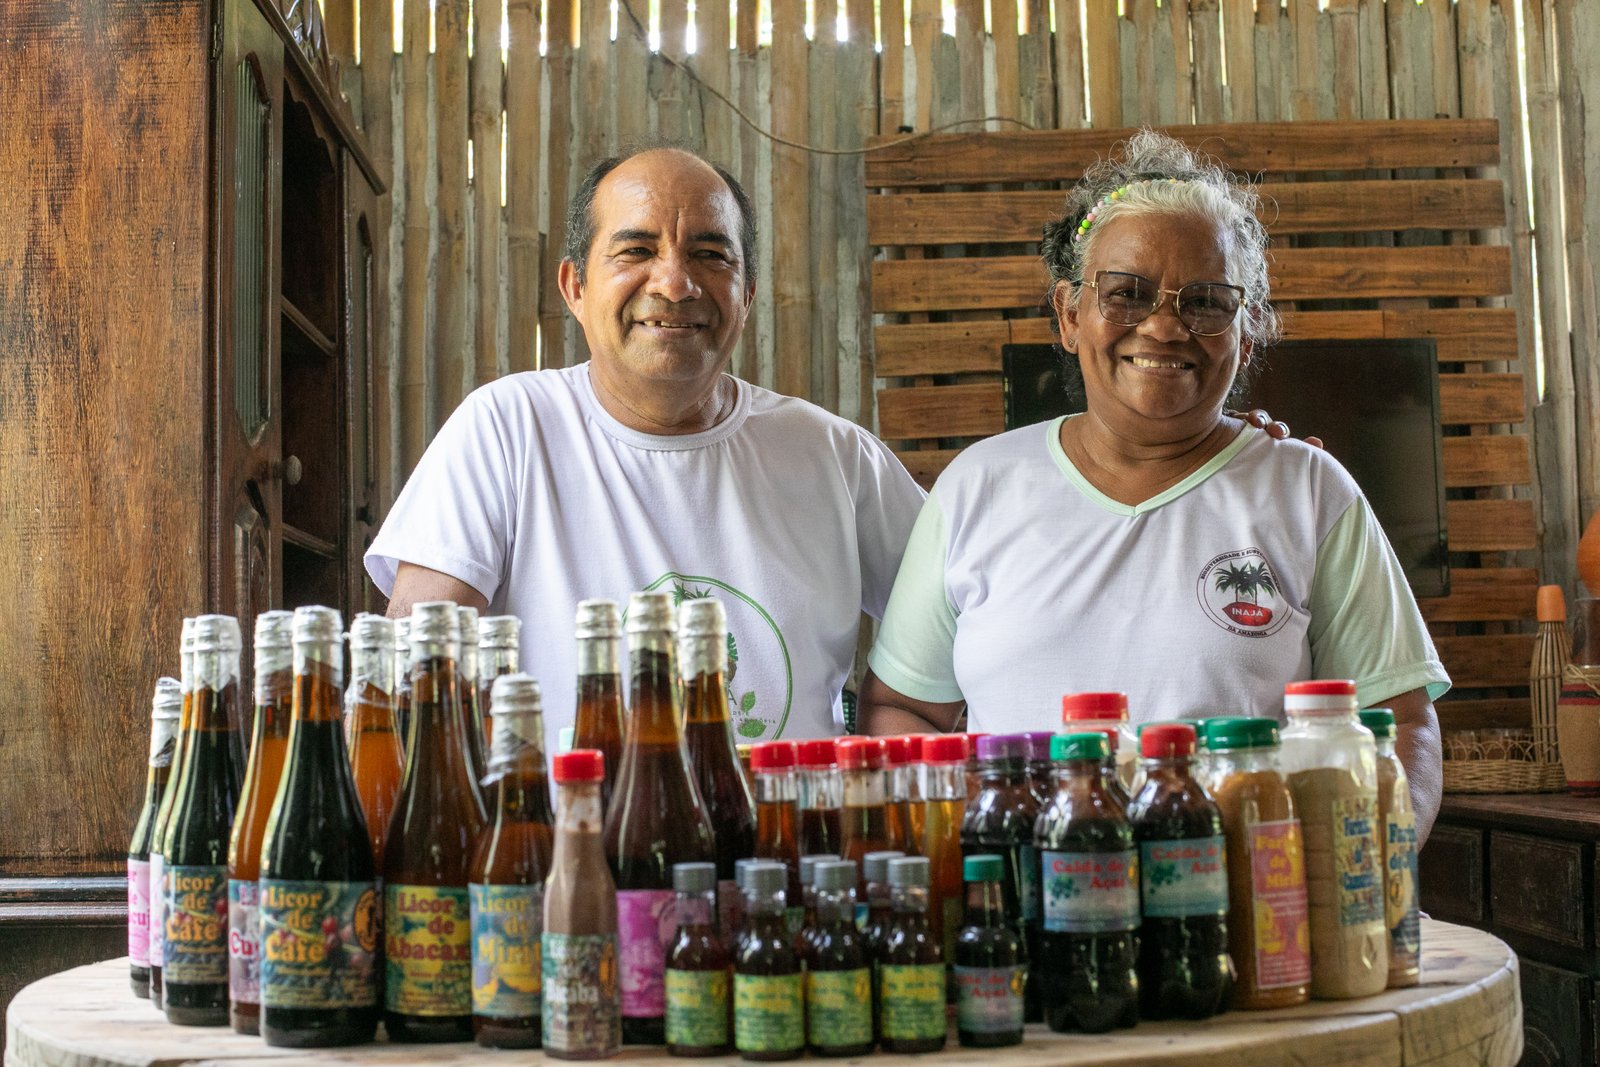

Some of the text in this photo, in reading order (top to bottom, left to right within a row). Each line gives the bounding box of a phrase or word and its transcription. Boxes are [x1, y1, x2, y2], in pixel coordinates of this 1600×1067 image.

[1232, 607, 1264, 617] INAJÁ
[1052, 858, 1125, 873] Calda de
[183, 892, 207, 911] de
[267, 886, 323, 909] Licor
[398, 892, 456, 914] Licor
[476, 890, 530, 913] Licor
[287, 909, 313, 929] de
[427, 915, 456, 935] de
[265, 931, 325, 963] Café
